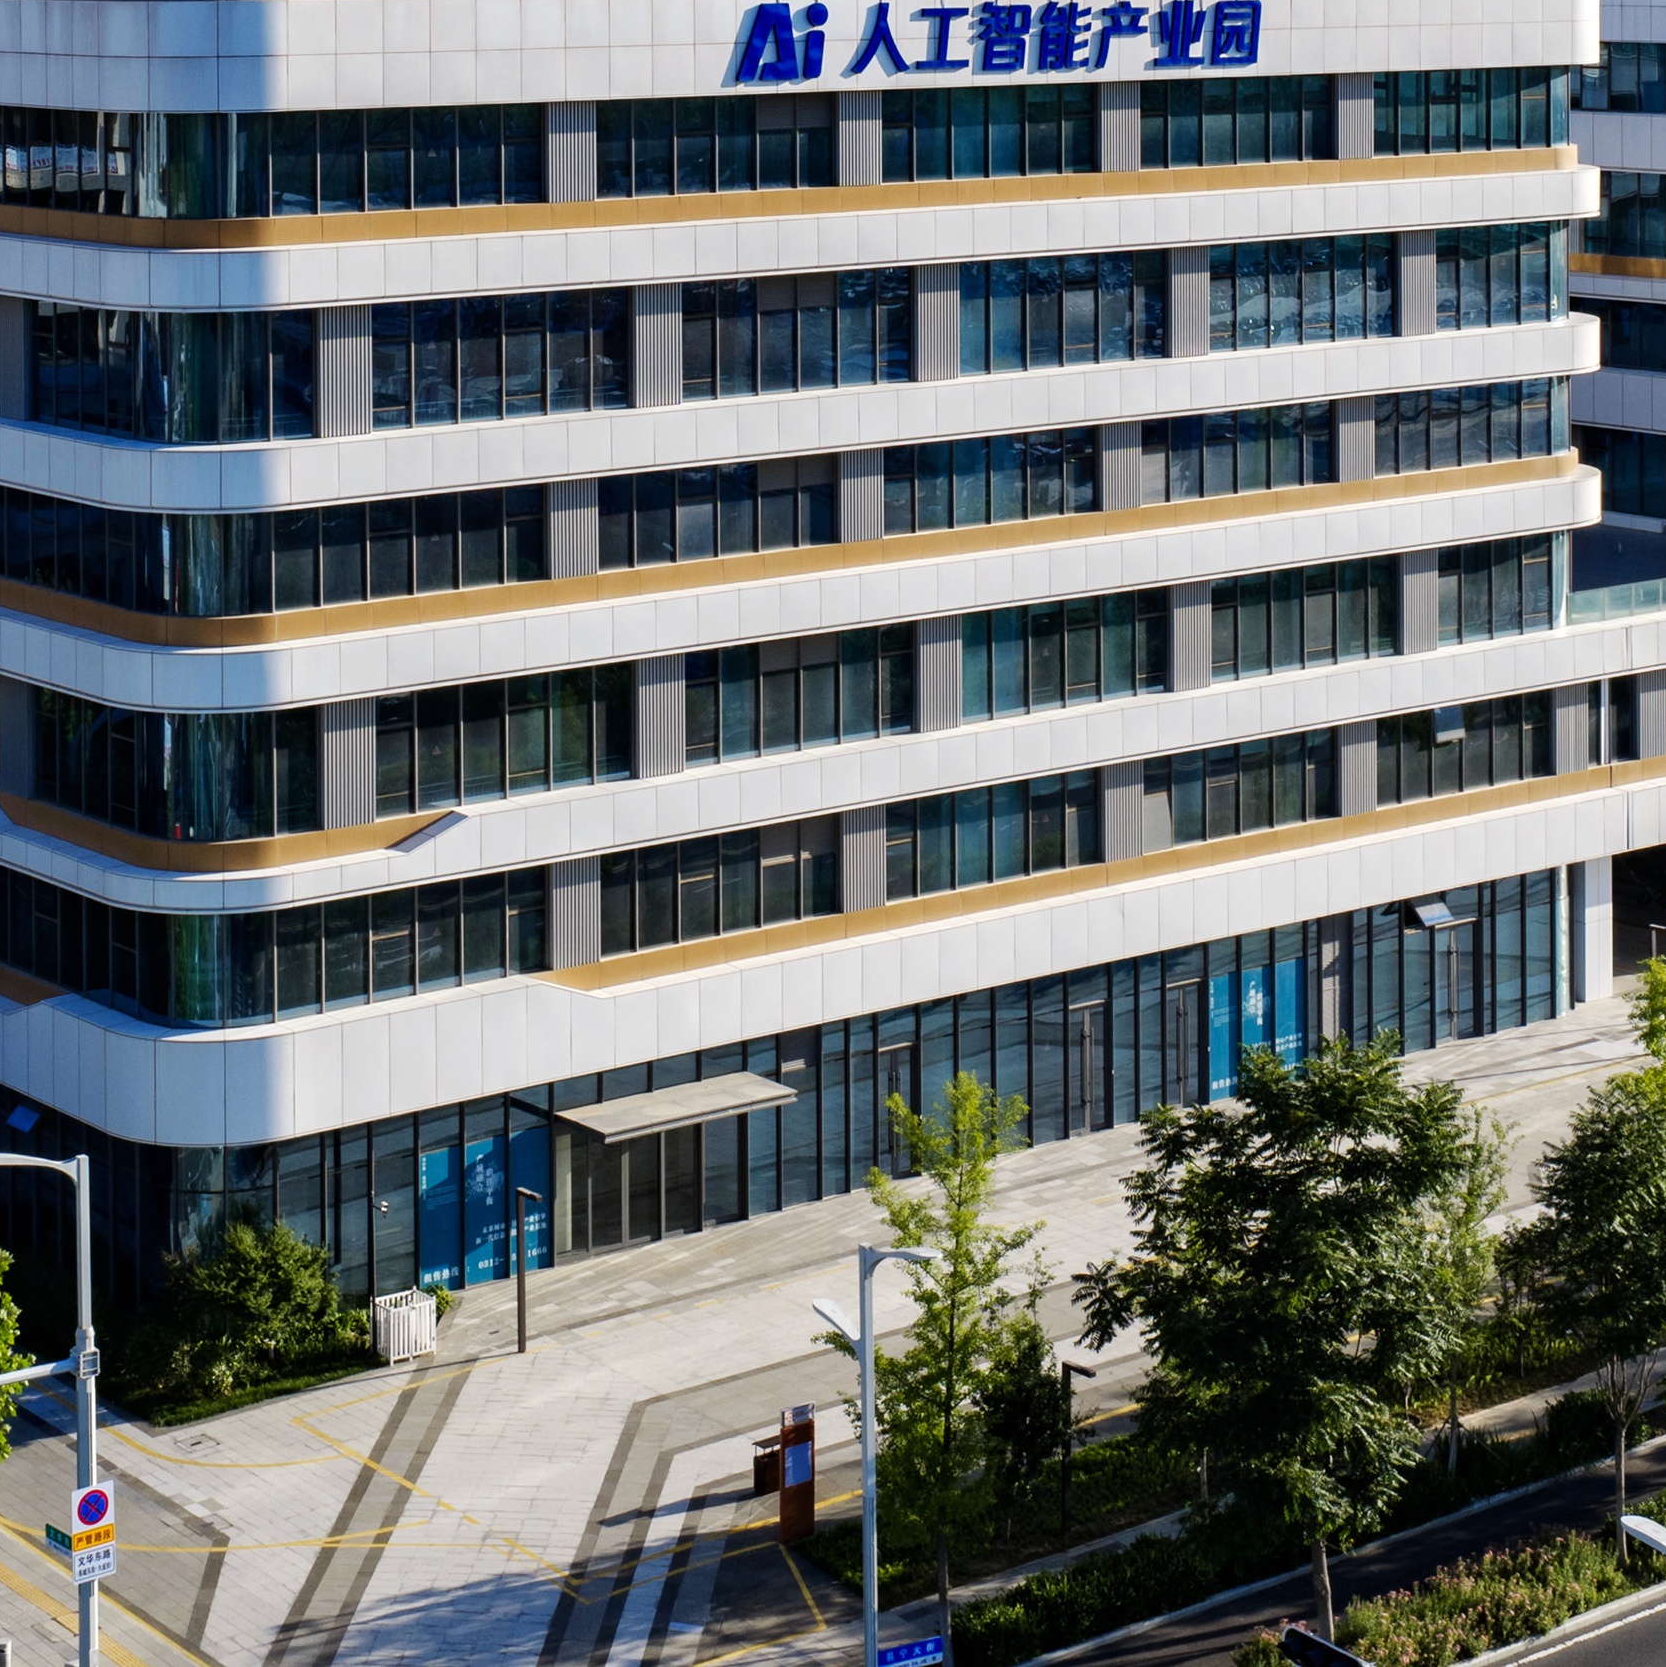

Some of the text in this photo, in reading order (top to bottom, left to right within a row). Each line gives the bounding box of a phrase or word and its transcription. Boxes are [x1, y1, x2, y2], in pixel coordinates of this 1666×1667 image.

[850, 0, 1263, 75] 人工智能产业园
[76, 1529, 111, 1549] 严管路段
[78, 1549, 111, 1568] 文华东路
